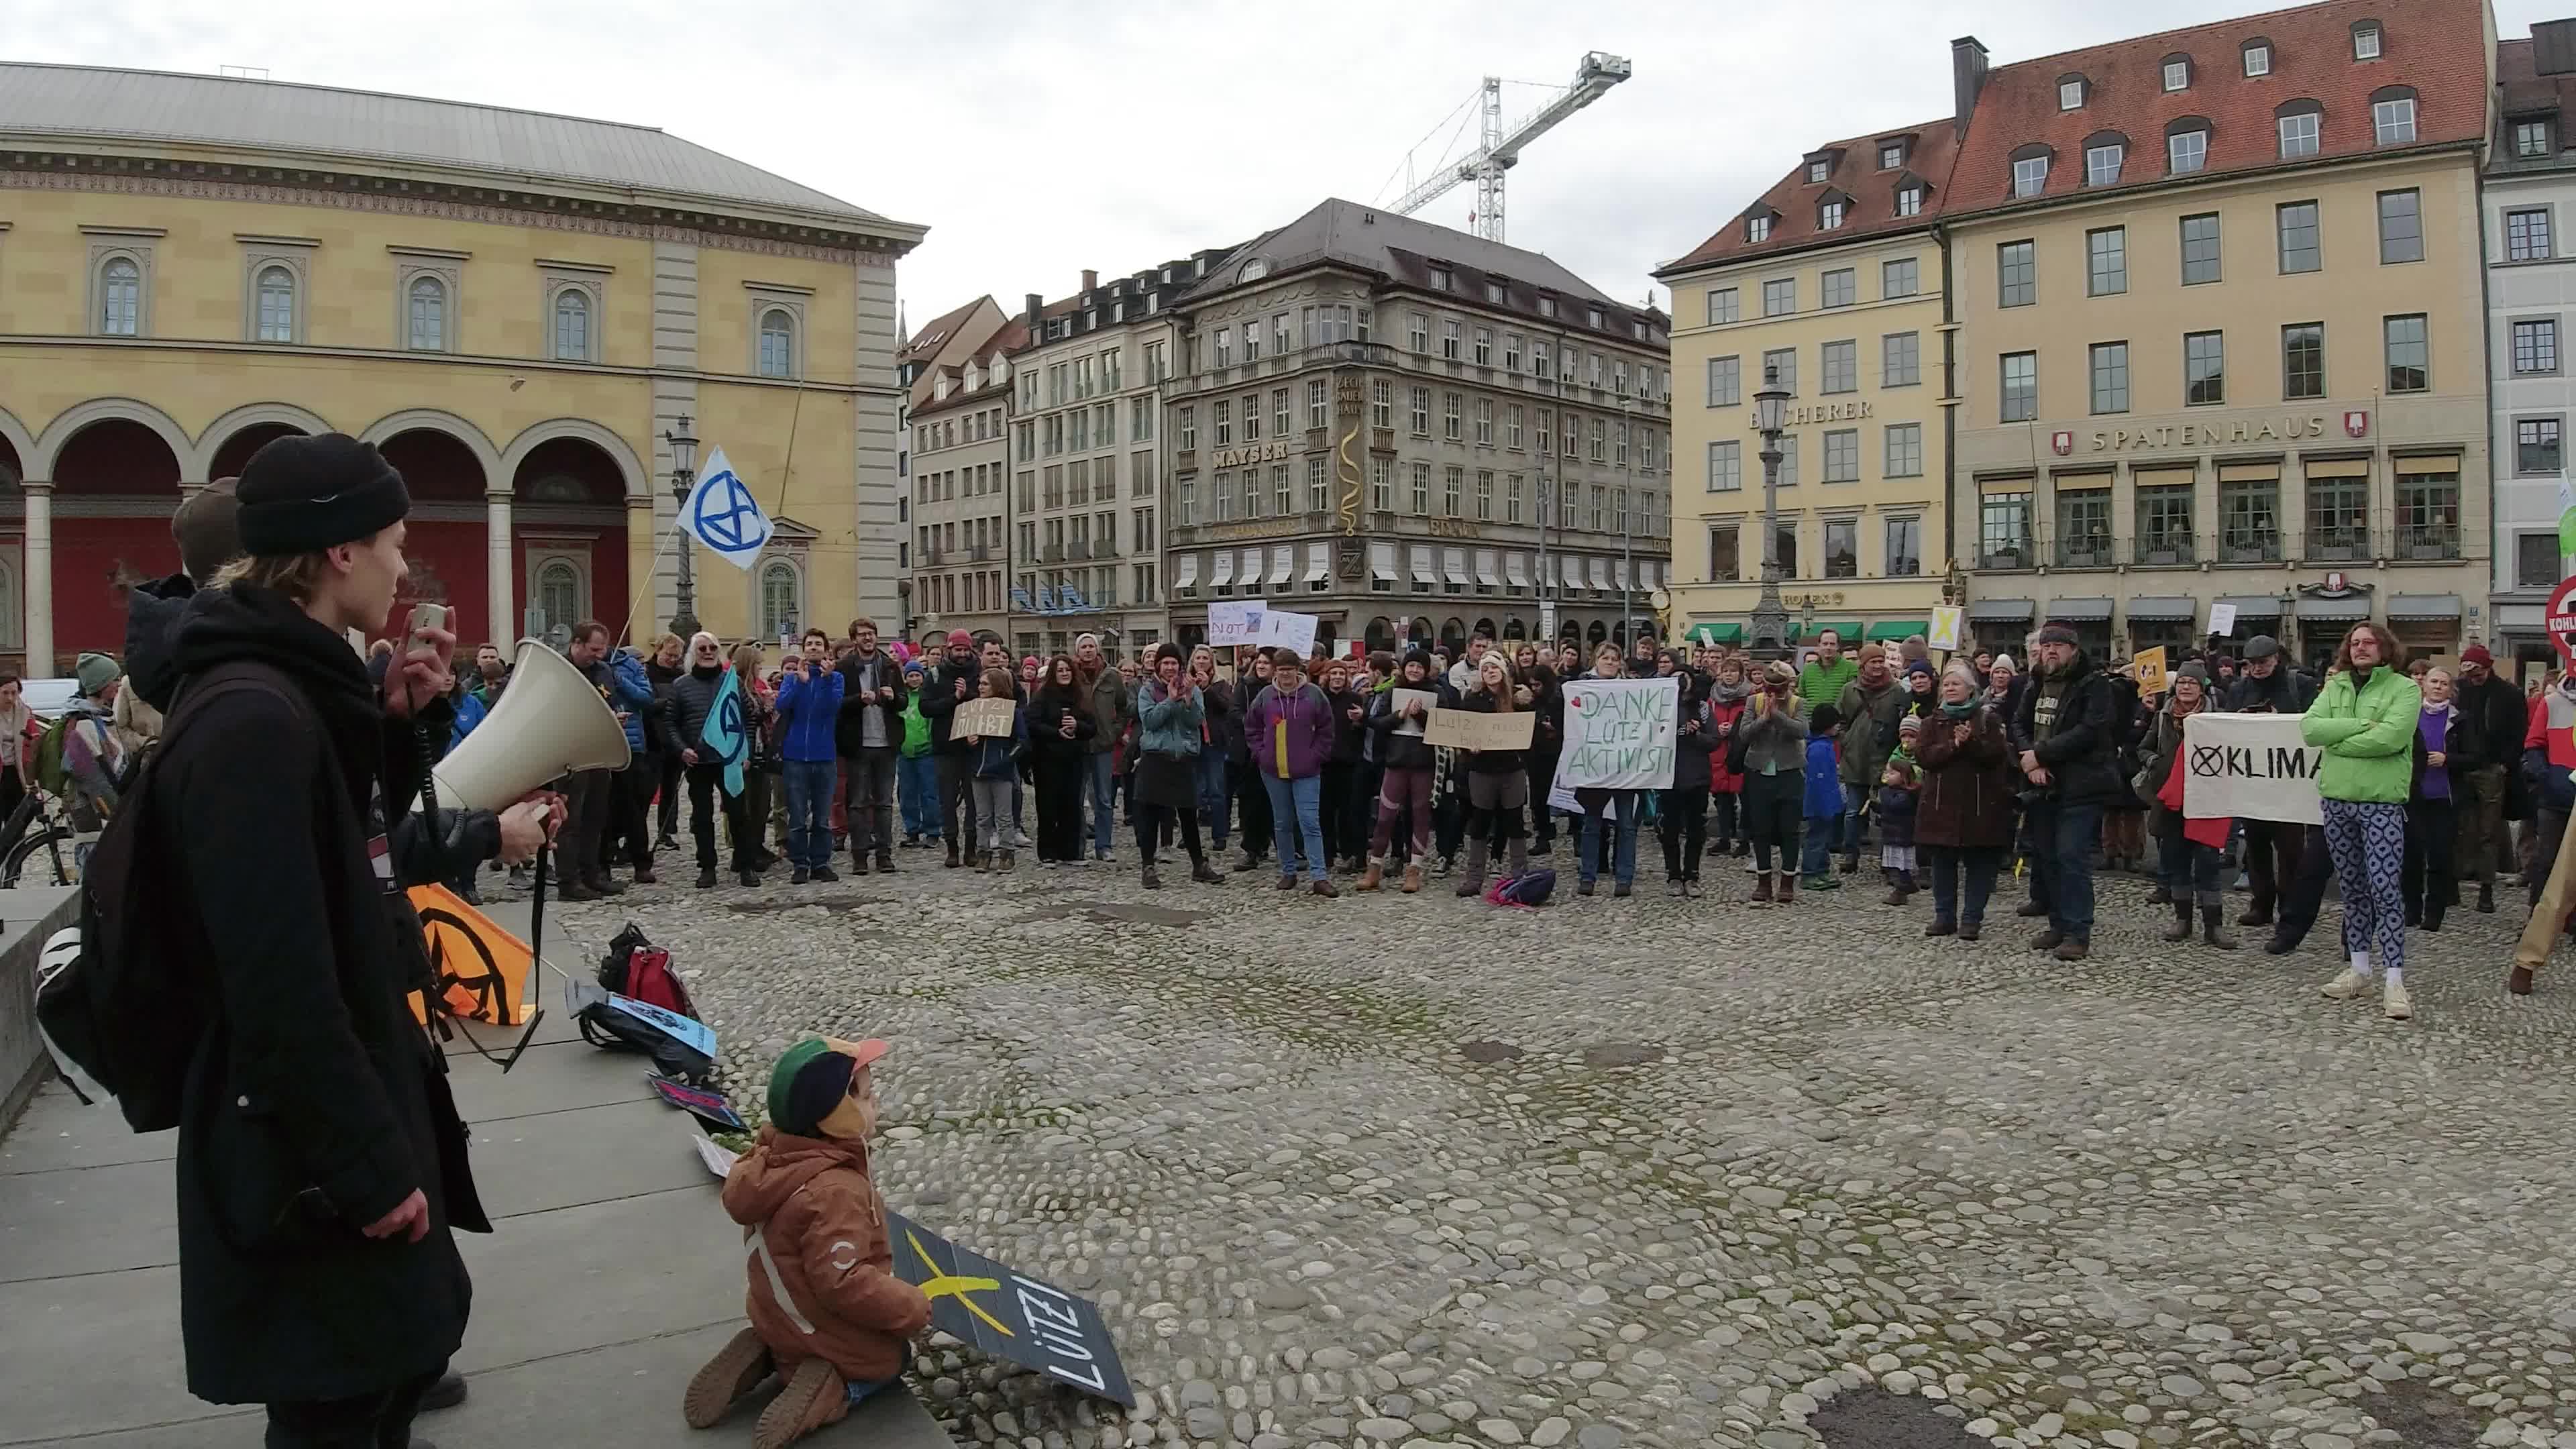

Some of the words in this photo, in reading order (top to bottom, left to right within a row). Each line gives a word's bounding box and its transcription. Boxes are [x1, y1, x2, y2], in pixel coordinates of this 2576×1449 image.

[1750, 402, 1873, 429] BCHERER
[2092, 417, 2324, 450] SPATENHAUS
[1213, 442, 1287, 468] MAYSER
[1784, 594, 1829, 604] ROEX
[1212, 622, 1245, 634] NOT
[2549, 616, 2576, 631] KOHL
[1580, 687, 1672, 722] DANKE
[1585, 719, 1653, 744] LÜTZI
[1566, 746, 1674, 778] AKTIVISTI
[1009, 1275, 1106, 1391] LÜTZI
